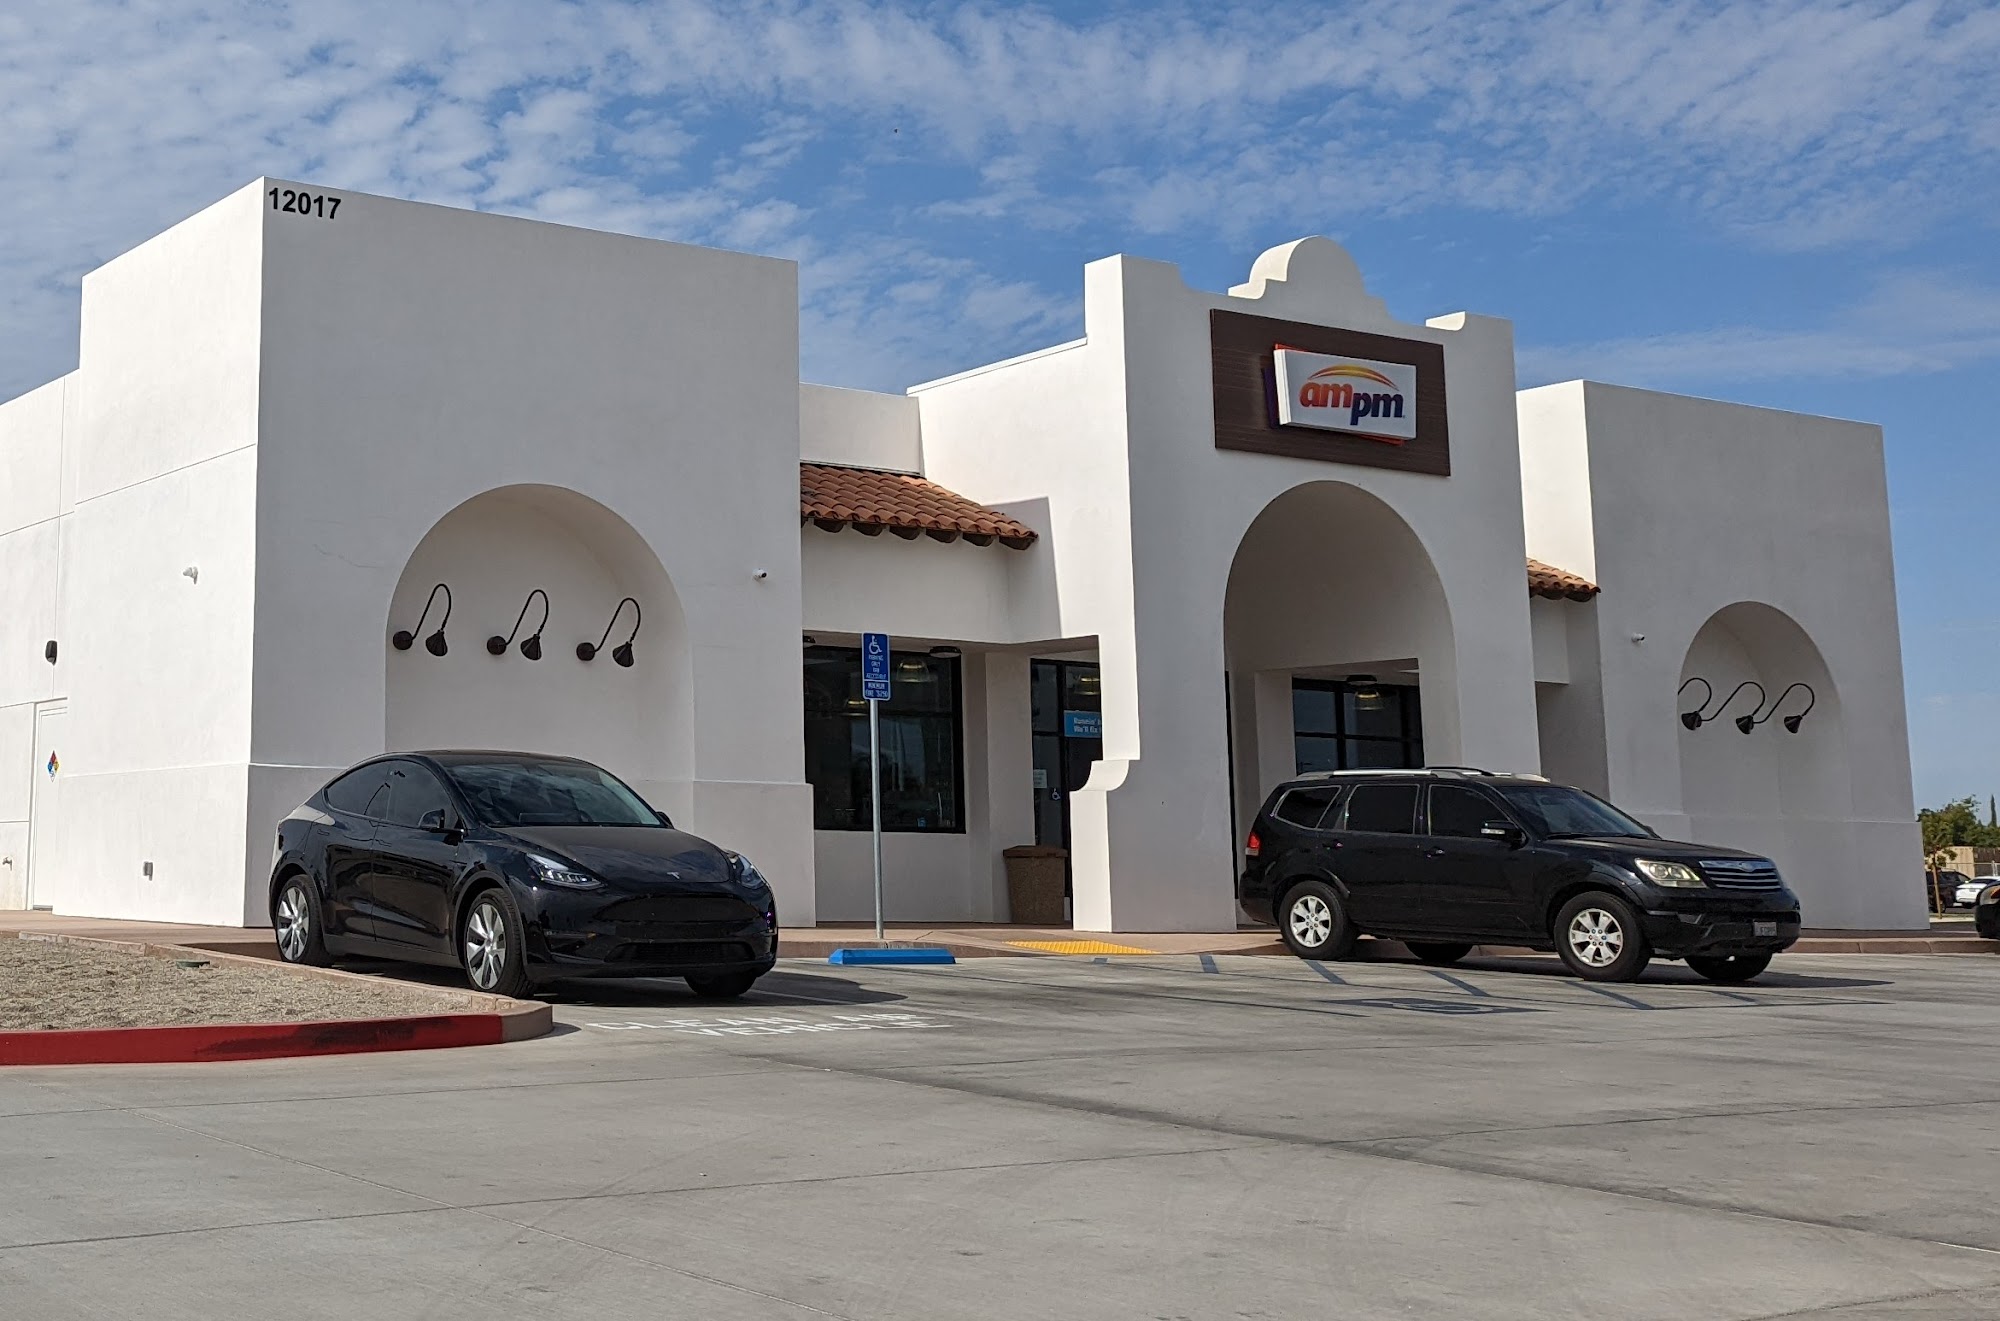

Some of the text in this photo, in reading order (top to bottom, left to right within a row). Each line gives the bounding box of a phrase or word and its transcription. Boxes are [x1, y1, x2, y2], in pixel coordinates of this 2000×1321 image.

[269, 187, 341, 219] 12017
[1300, 382, 1403, 425] ampm
[585, 1013, 936, 1030] CLEAN AIR
[673, 1021, 953, 1036] VEHICLE
